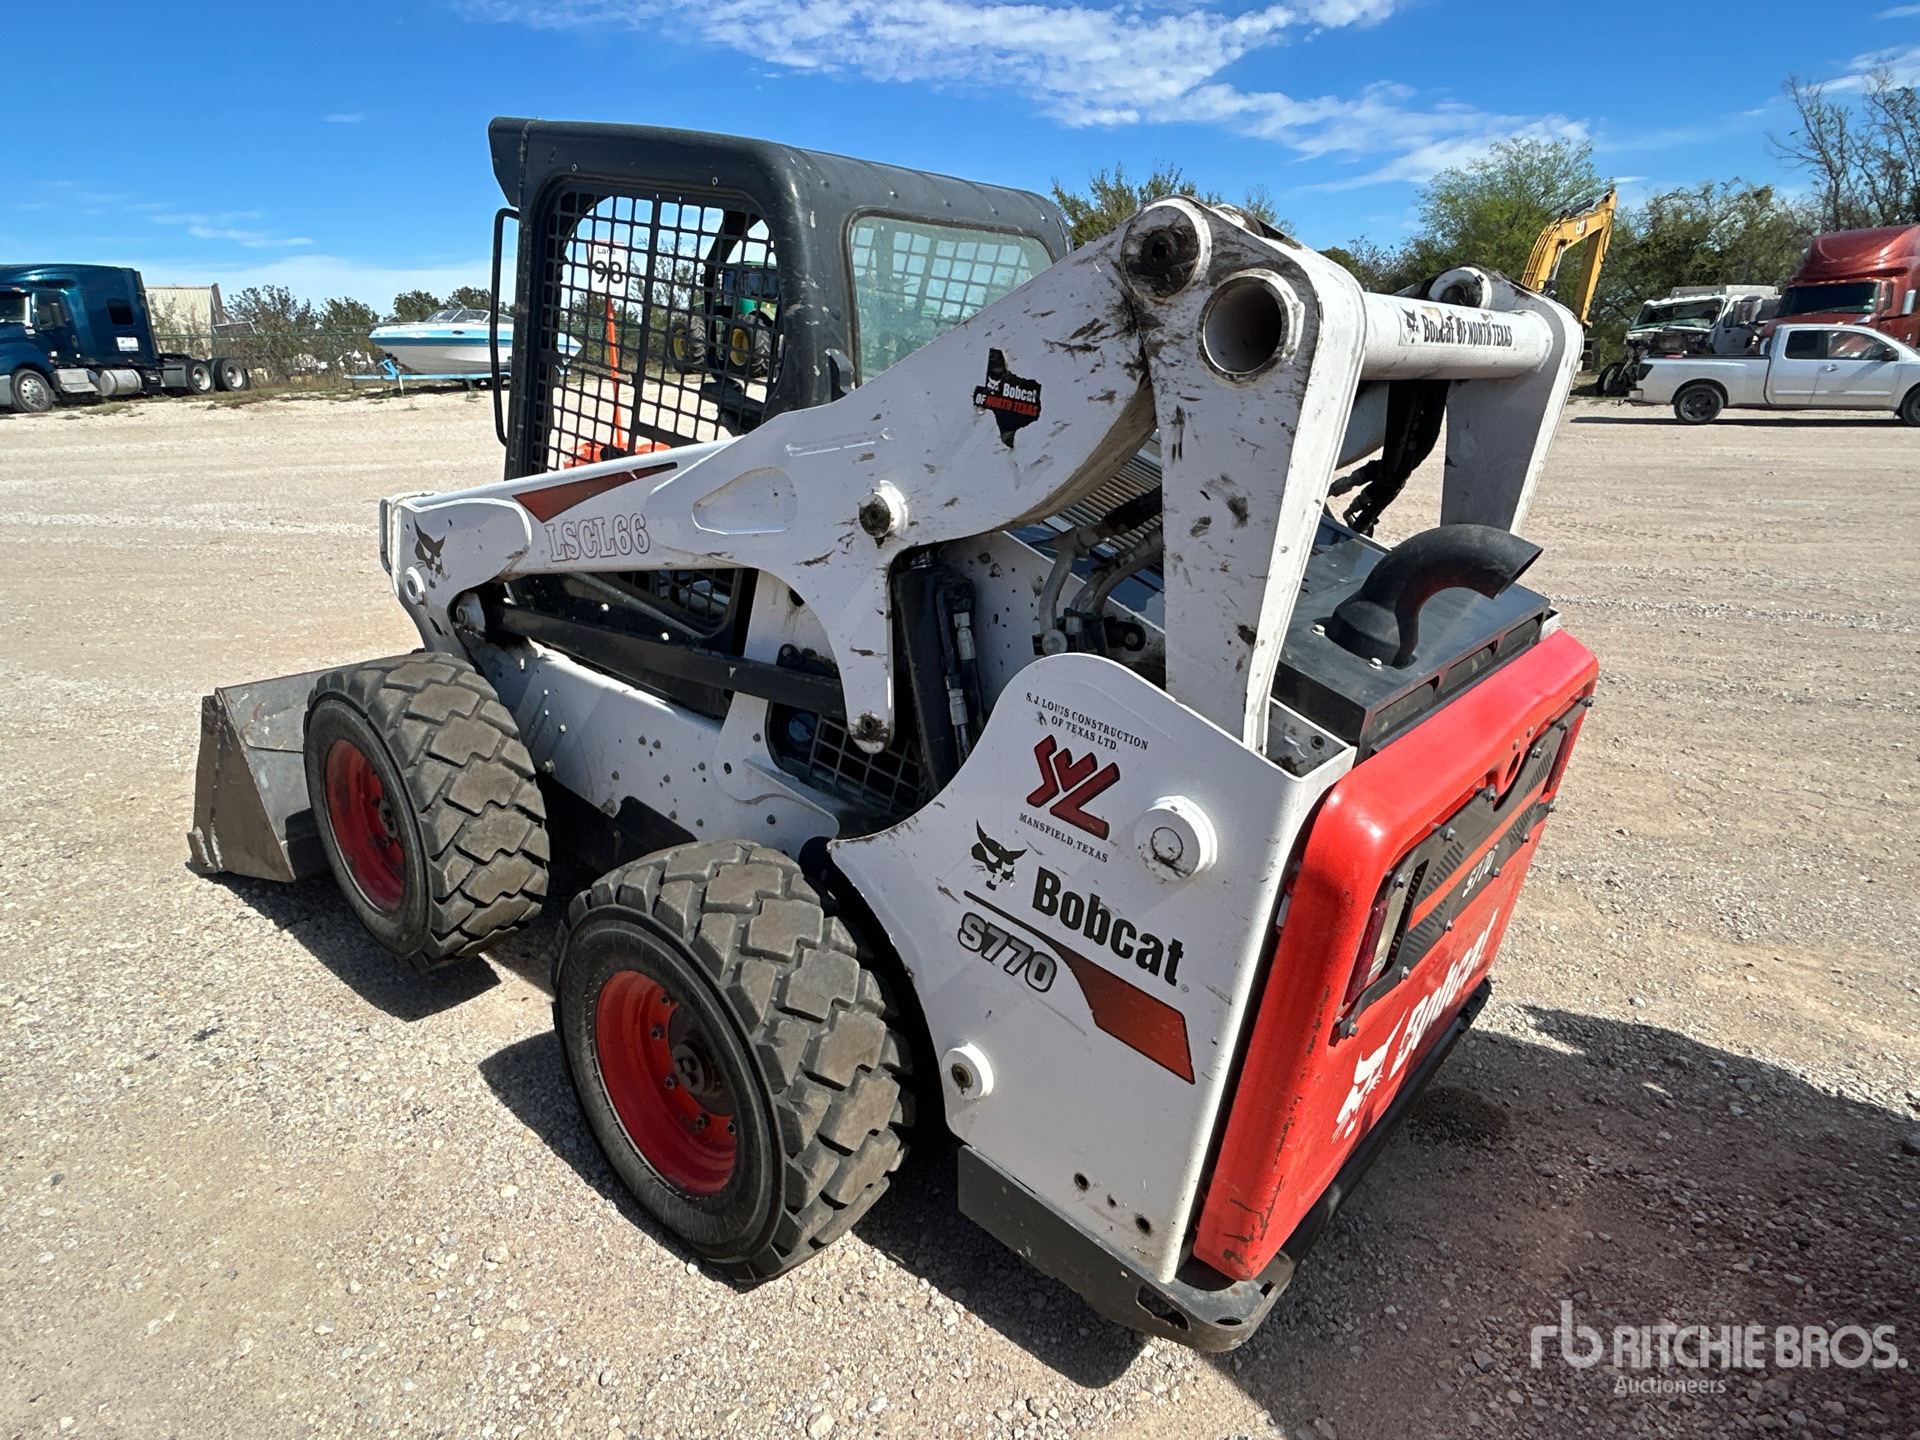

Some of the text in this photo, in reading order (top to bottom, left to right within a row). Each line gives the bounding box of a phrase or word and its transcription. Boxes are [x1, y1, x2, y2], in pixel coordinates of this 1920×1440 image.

[593, 259, 624, 285] 98
[1467, 320, 1492, 346] NORTH
[1491, 323, 1513, 347] TEXAS
[975, 393, 1039, 417] OF NORTH TEXAS
[1002, 382, 1038, 403] Bobcat
[544, 512, 651, 563] LSCL66
[1041, 699, 1071, 718] LOUIS
[1071, 711, 1149, 751] CONSTRUCTION
[1051, 715, 1064, 727] OF
[1065, 721, 1096, 742] TEXAS
[1031, 866, 1184, 988] Bobcat
[957, 911, 1058, 993] S770
